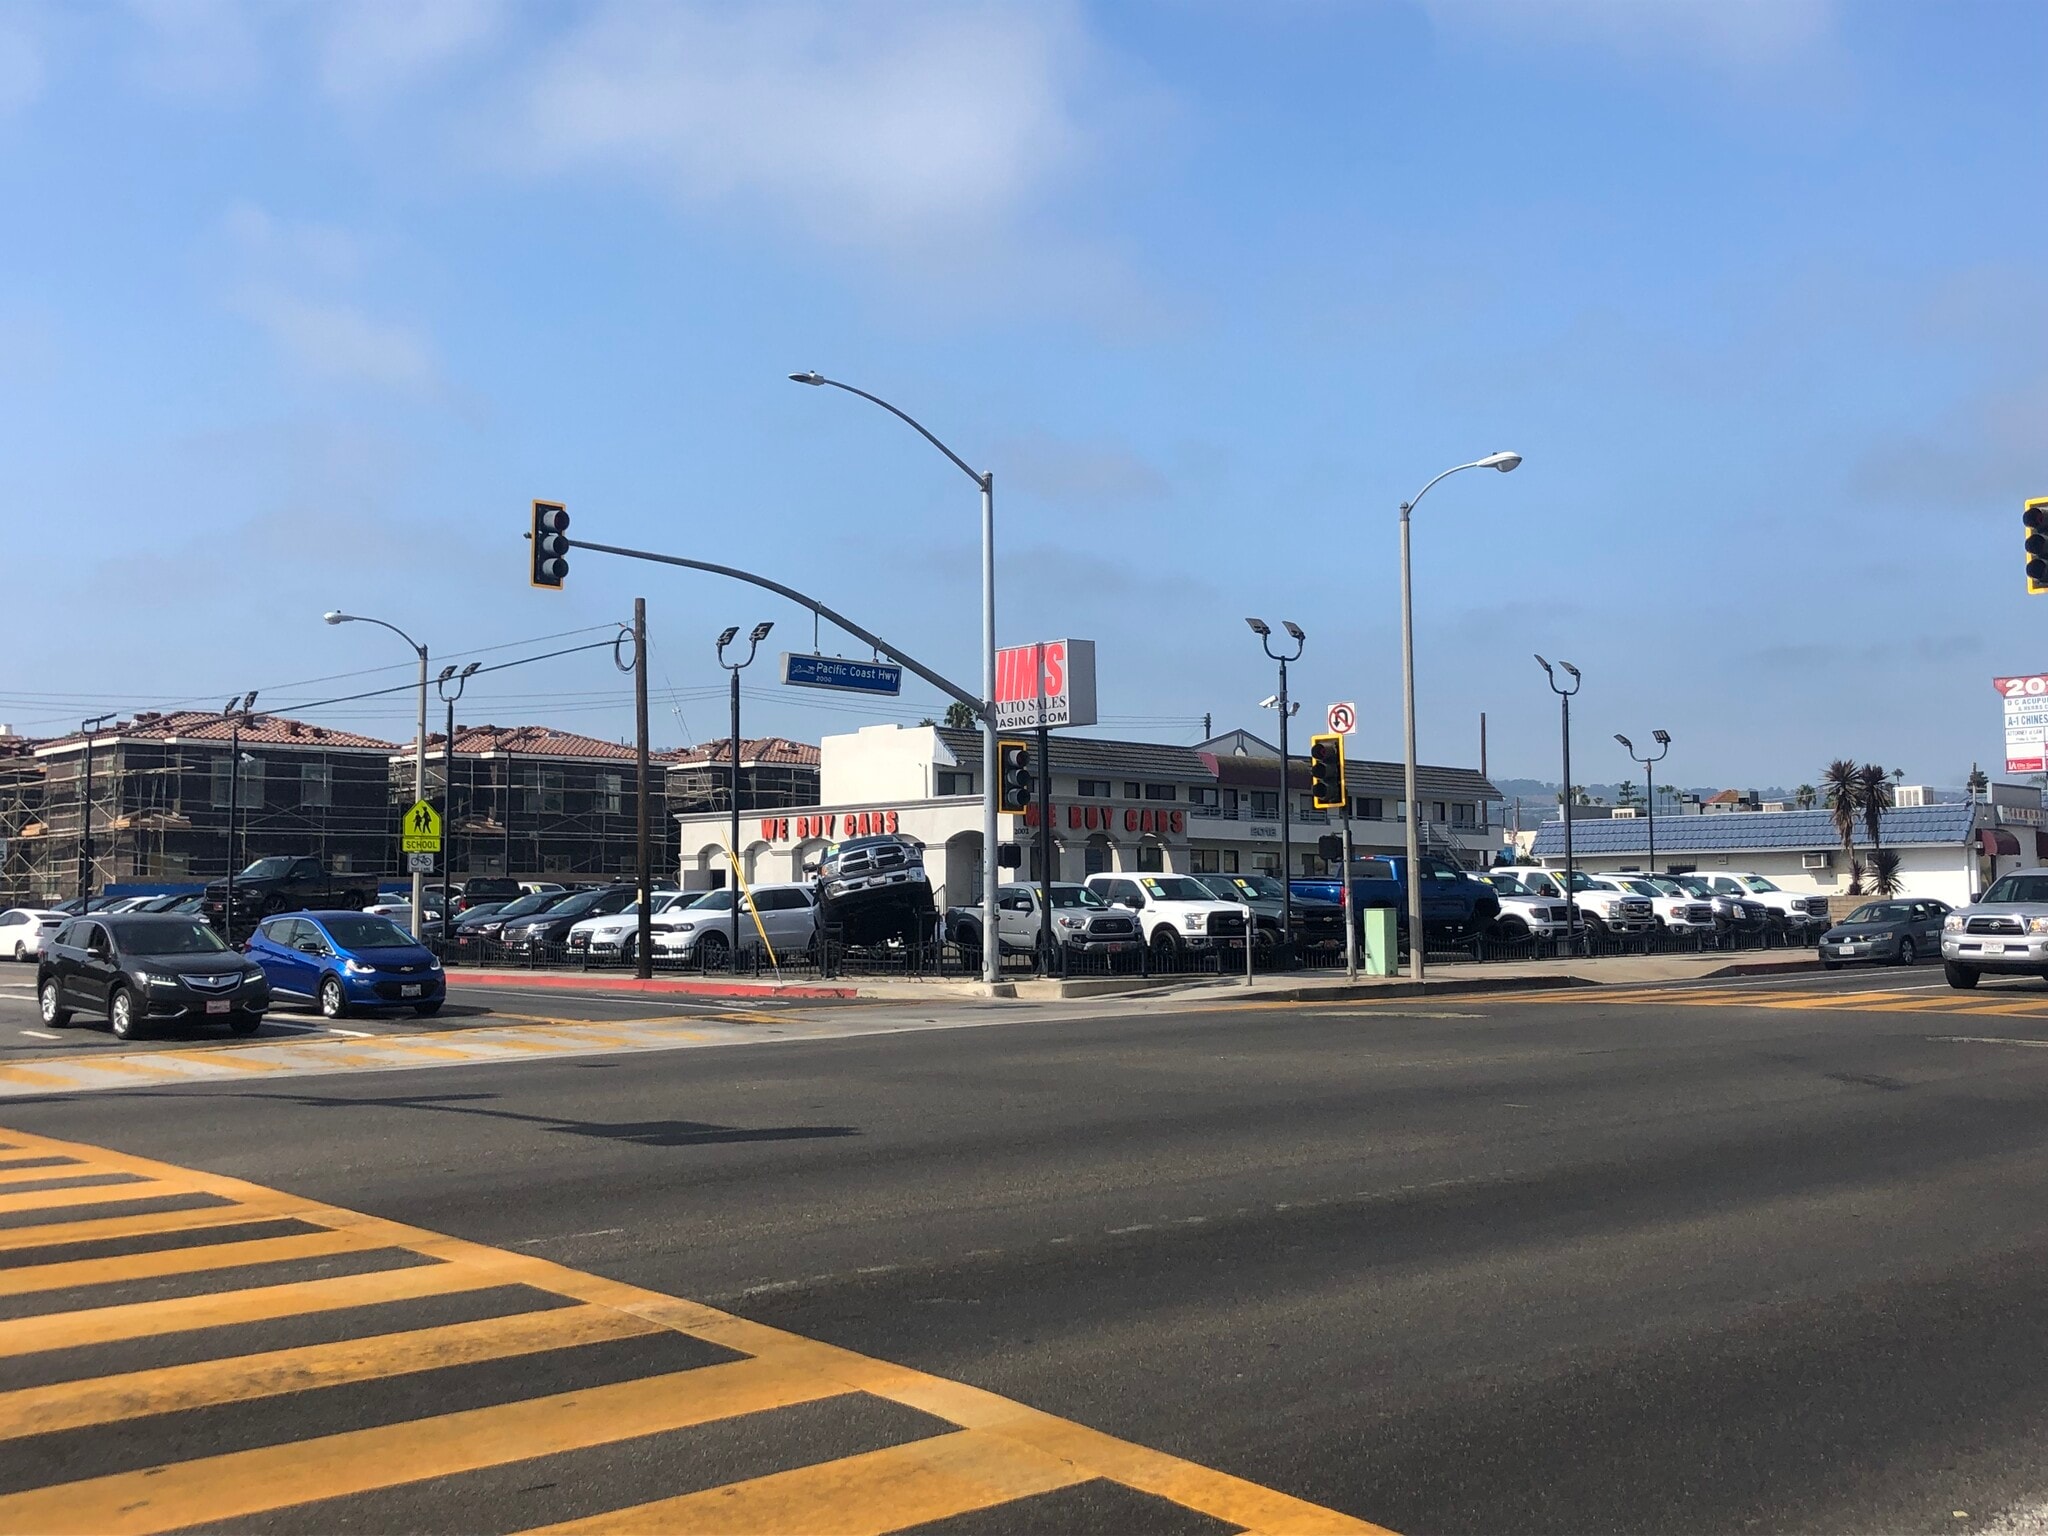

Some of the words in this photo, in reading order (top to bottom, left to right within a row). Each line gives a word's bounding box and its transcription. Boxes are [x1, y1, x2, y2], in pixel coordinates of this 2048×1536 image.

[816, 662, 847, 676] Pacific
[849, 666, 876, 680] Coast
[878, 670, 898, 684] Hwy
[816, 675, 832, 683] 2000
[2005, 677, 2048, 697] 20
[1028, 696, 1066, 711] SALES
[2022, 697, 2048, 705] ACUPU
[996, 712, 1068, 729] ASINC.COM
[2008, 716, 2019, 727] A-1
[761, 818, 788, 840] WE
[797, 815, 834, 838] BUY
[844, 811, 897, 836] CARS
[1024, 802, 1056, 828] WE
[1069, 806, 1113, 830] BUY
[1125, 808, 1183, 833] CARS
[406, 840, 438, 849] SCHOOL
